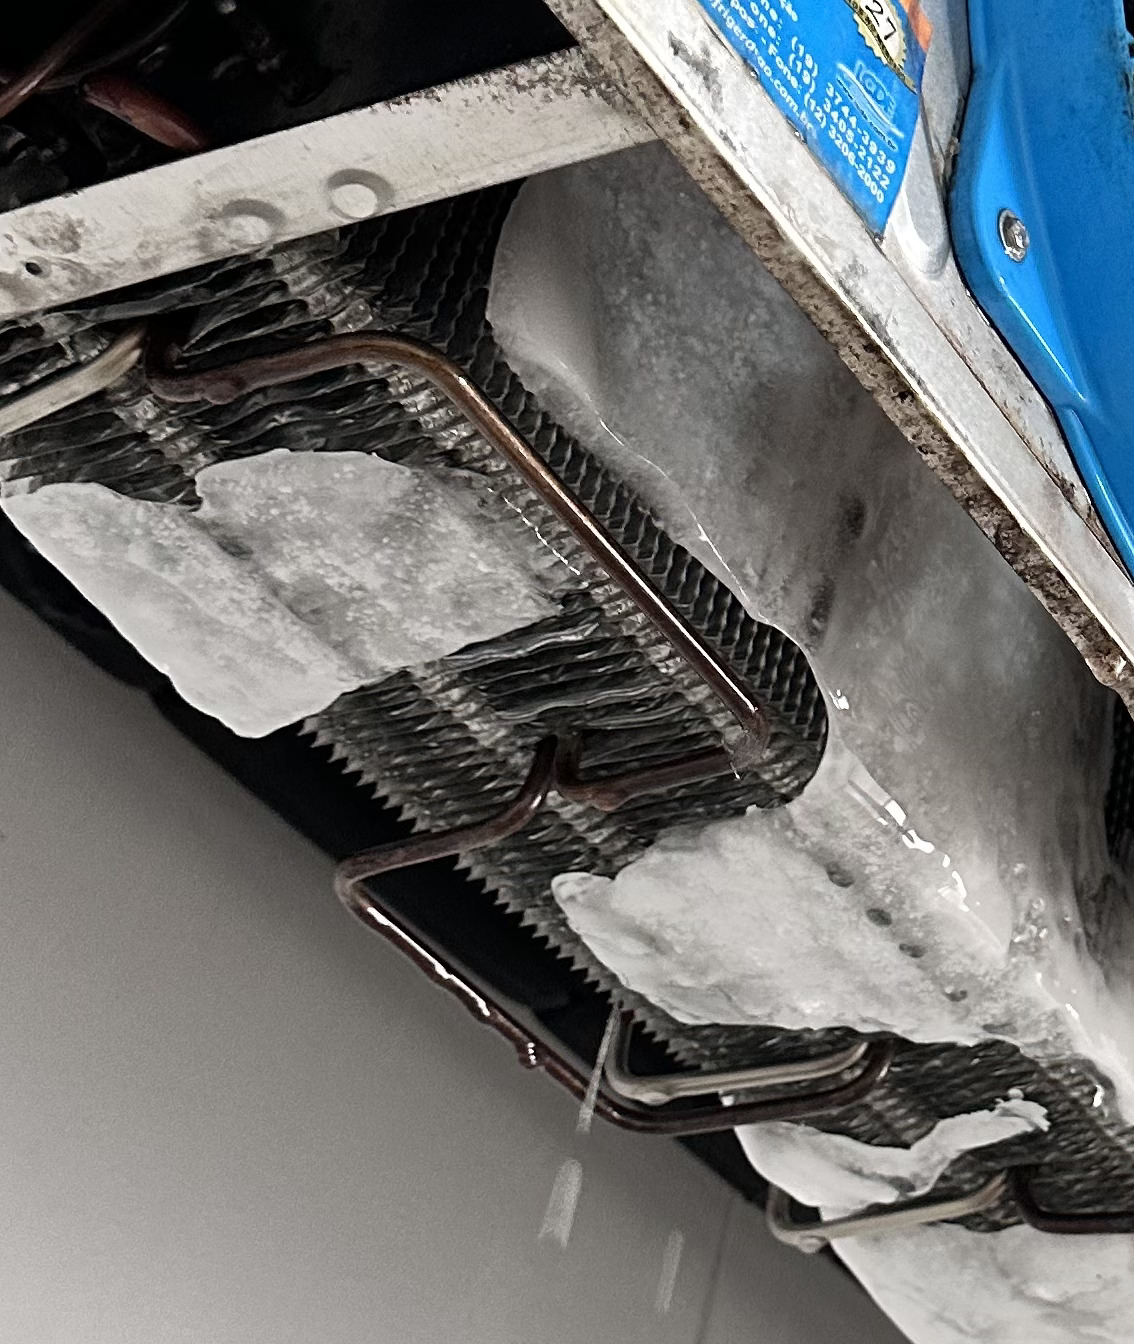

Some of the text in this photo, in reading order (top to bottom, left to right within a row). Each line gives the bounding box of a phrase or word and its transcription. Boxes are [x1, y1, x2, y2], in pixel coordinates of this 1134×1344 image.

[767, 42, 802, 94] Fone:
[803, 90, 826, 128] (12)
[827, 123, 884, 203] 3206-2000
[788, 48, 815, 94] (19)
[822, 97, 890, 190] 3405-2122
[791, 36, 818, 79] (19)
[825, 81, 895, 174] 3744-3939
